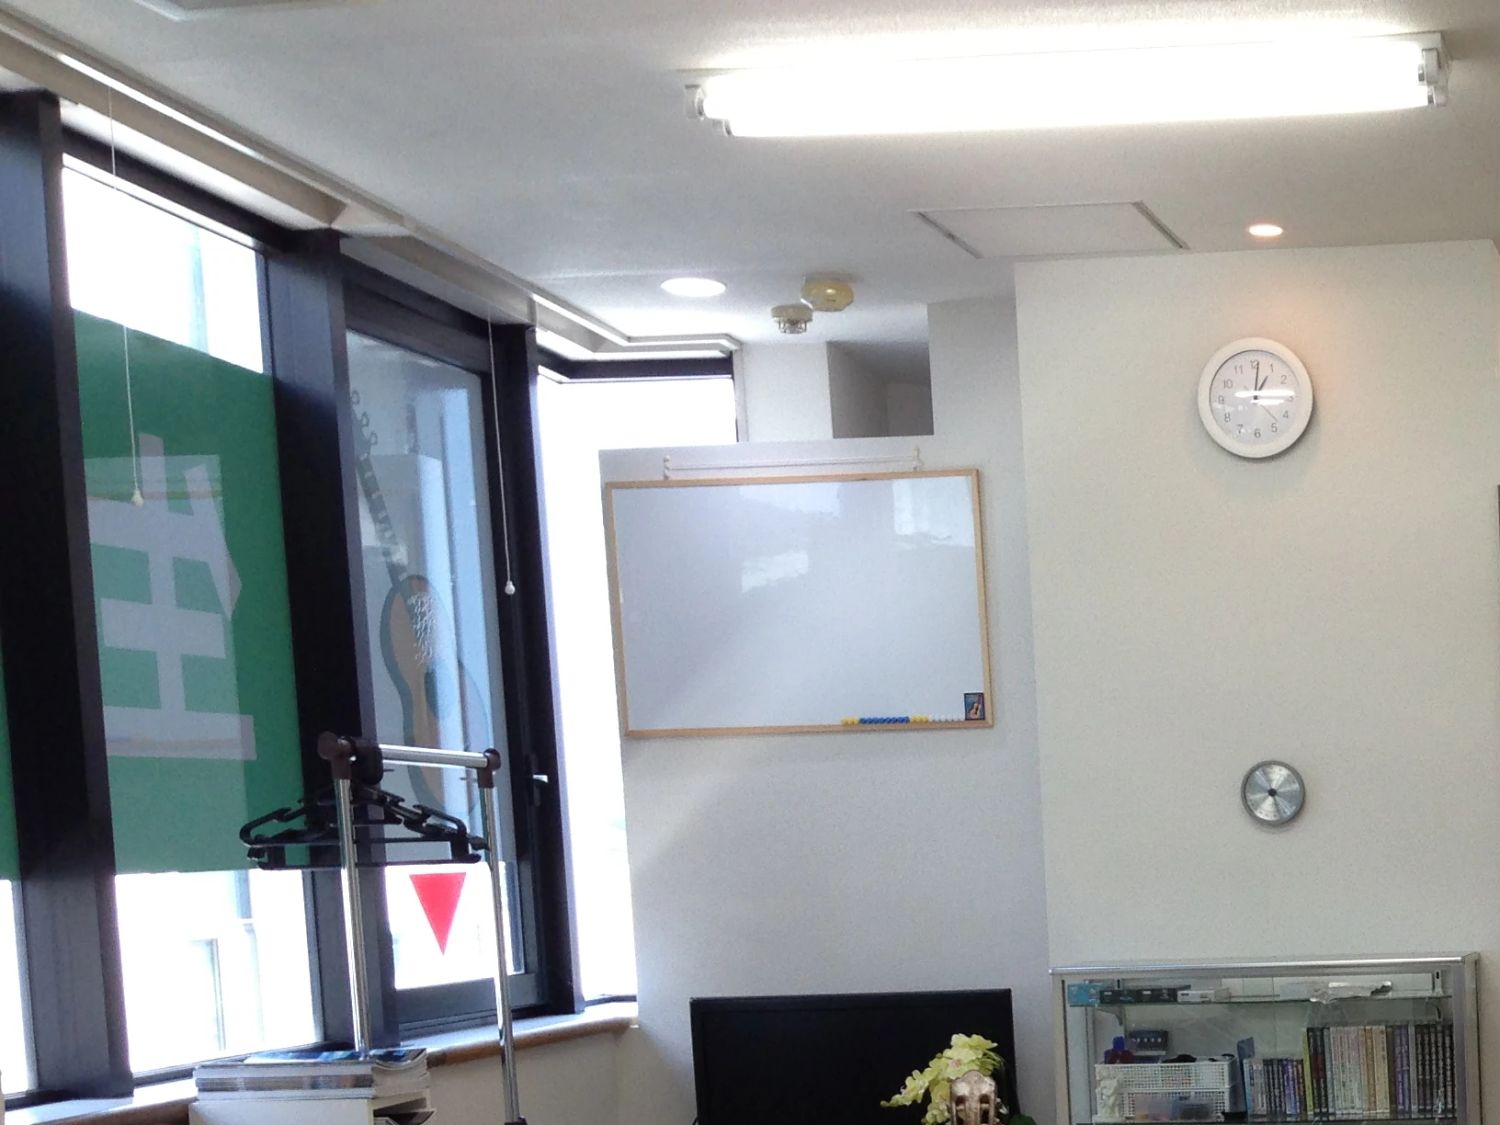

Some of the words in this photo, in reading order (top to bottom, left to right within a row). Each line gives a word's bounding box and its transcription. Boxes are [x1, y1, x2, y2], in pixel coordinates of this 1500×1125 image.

[1234, 364, 1243, 374] 11
[1223, 379, 1233, 389] 10
[1281, 375, 1288, 384] 2
[1218, 395, 1225, 404] 9
[1224, 412, 1231, 422] 8
[1282, 410, 1288, 419] 4
[1238, 424, 1243, 434] 7
[1271, 423, 1278, 433] 5
[1254, 429, 1261, 438] 6
